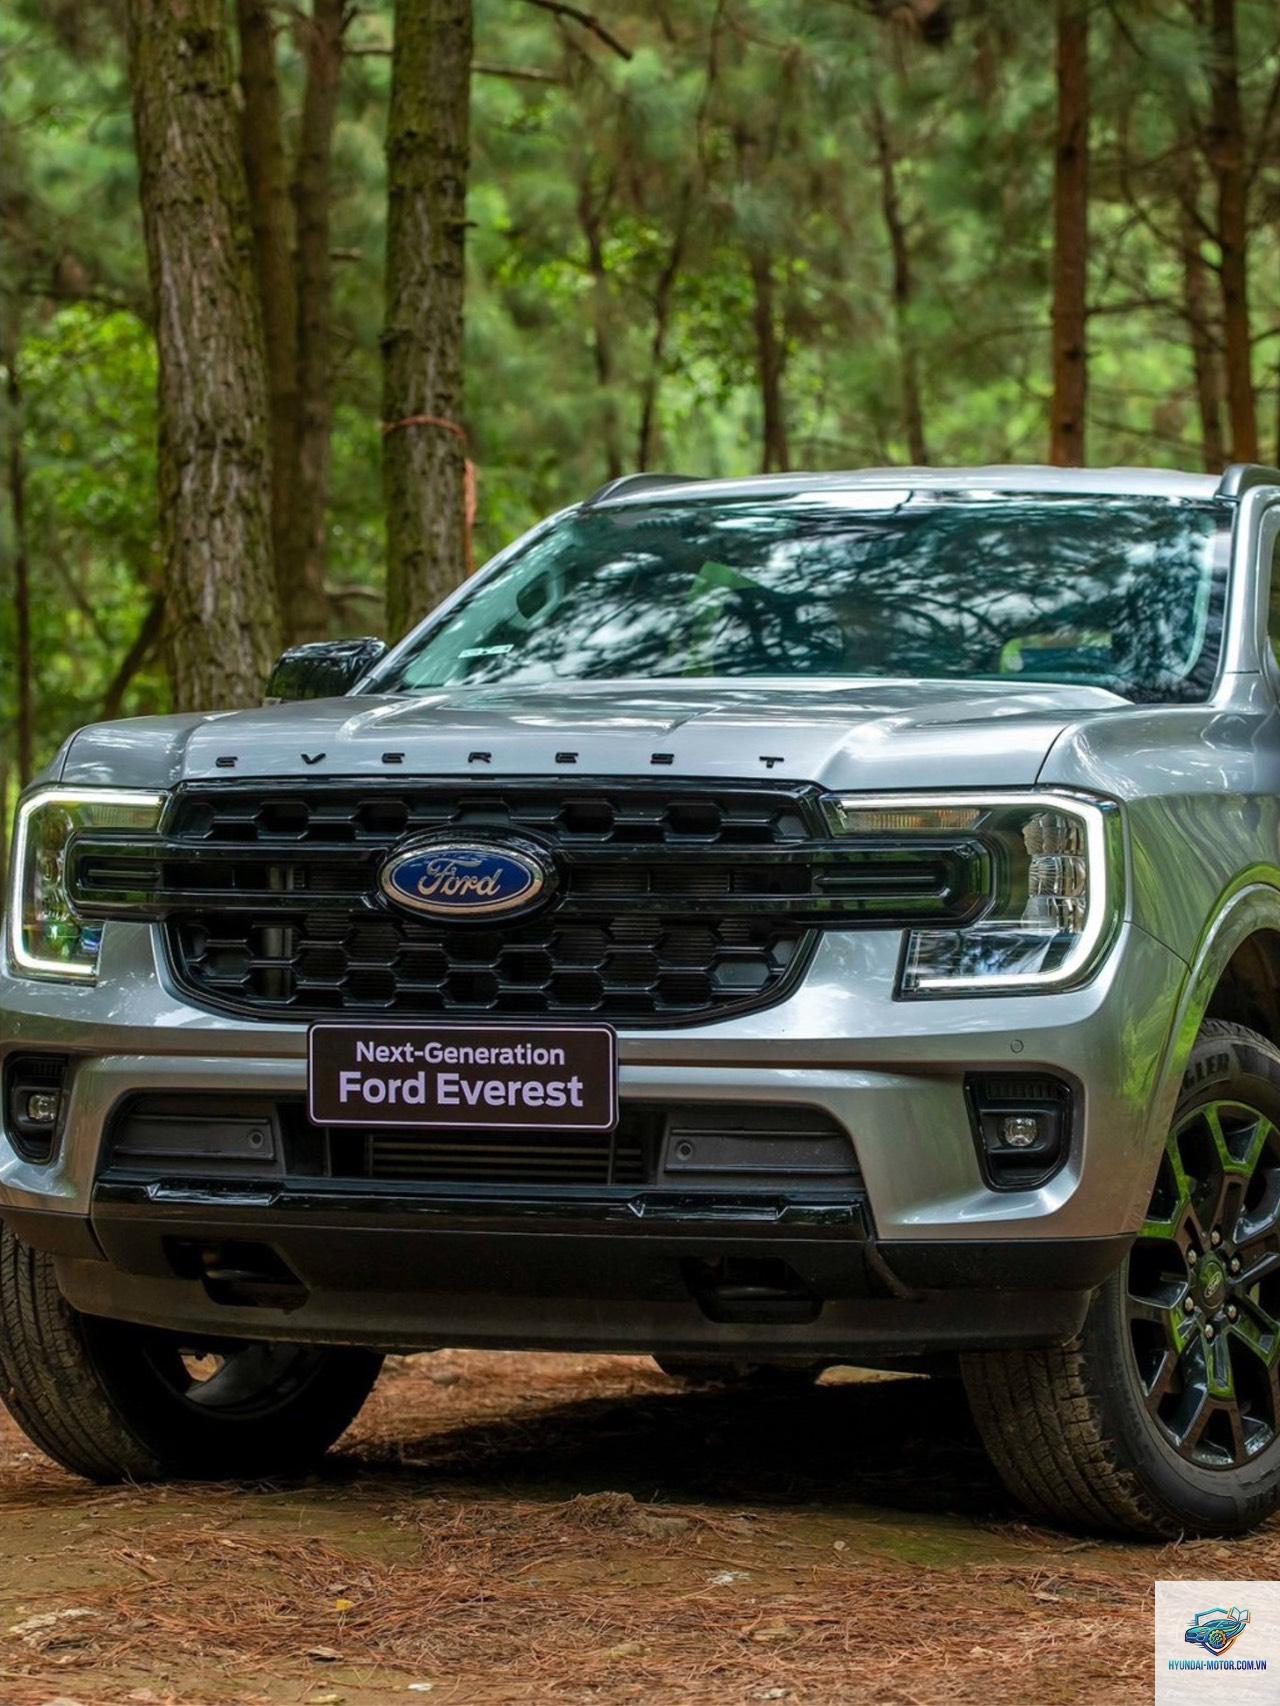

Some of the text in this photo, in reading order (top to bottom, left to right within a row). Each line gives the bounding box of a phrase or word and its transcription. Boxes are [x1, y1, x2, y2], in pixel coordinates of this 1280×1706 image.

[215, 751, 785, 769] EVEREST
[417, 858, 503, 896] Ford
[355, 1040, 566, 1066] Next-Generation
[338, 1070, 584, 1107] Ford Everest
